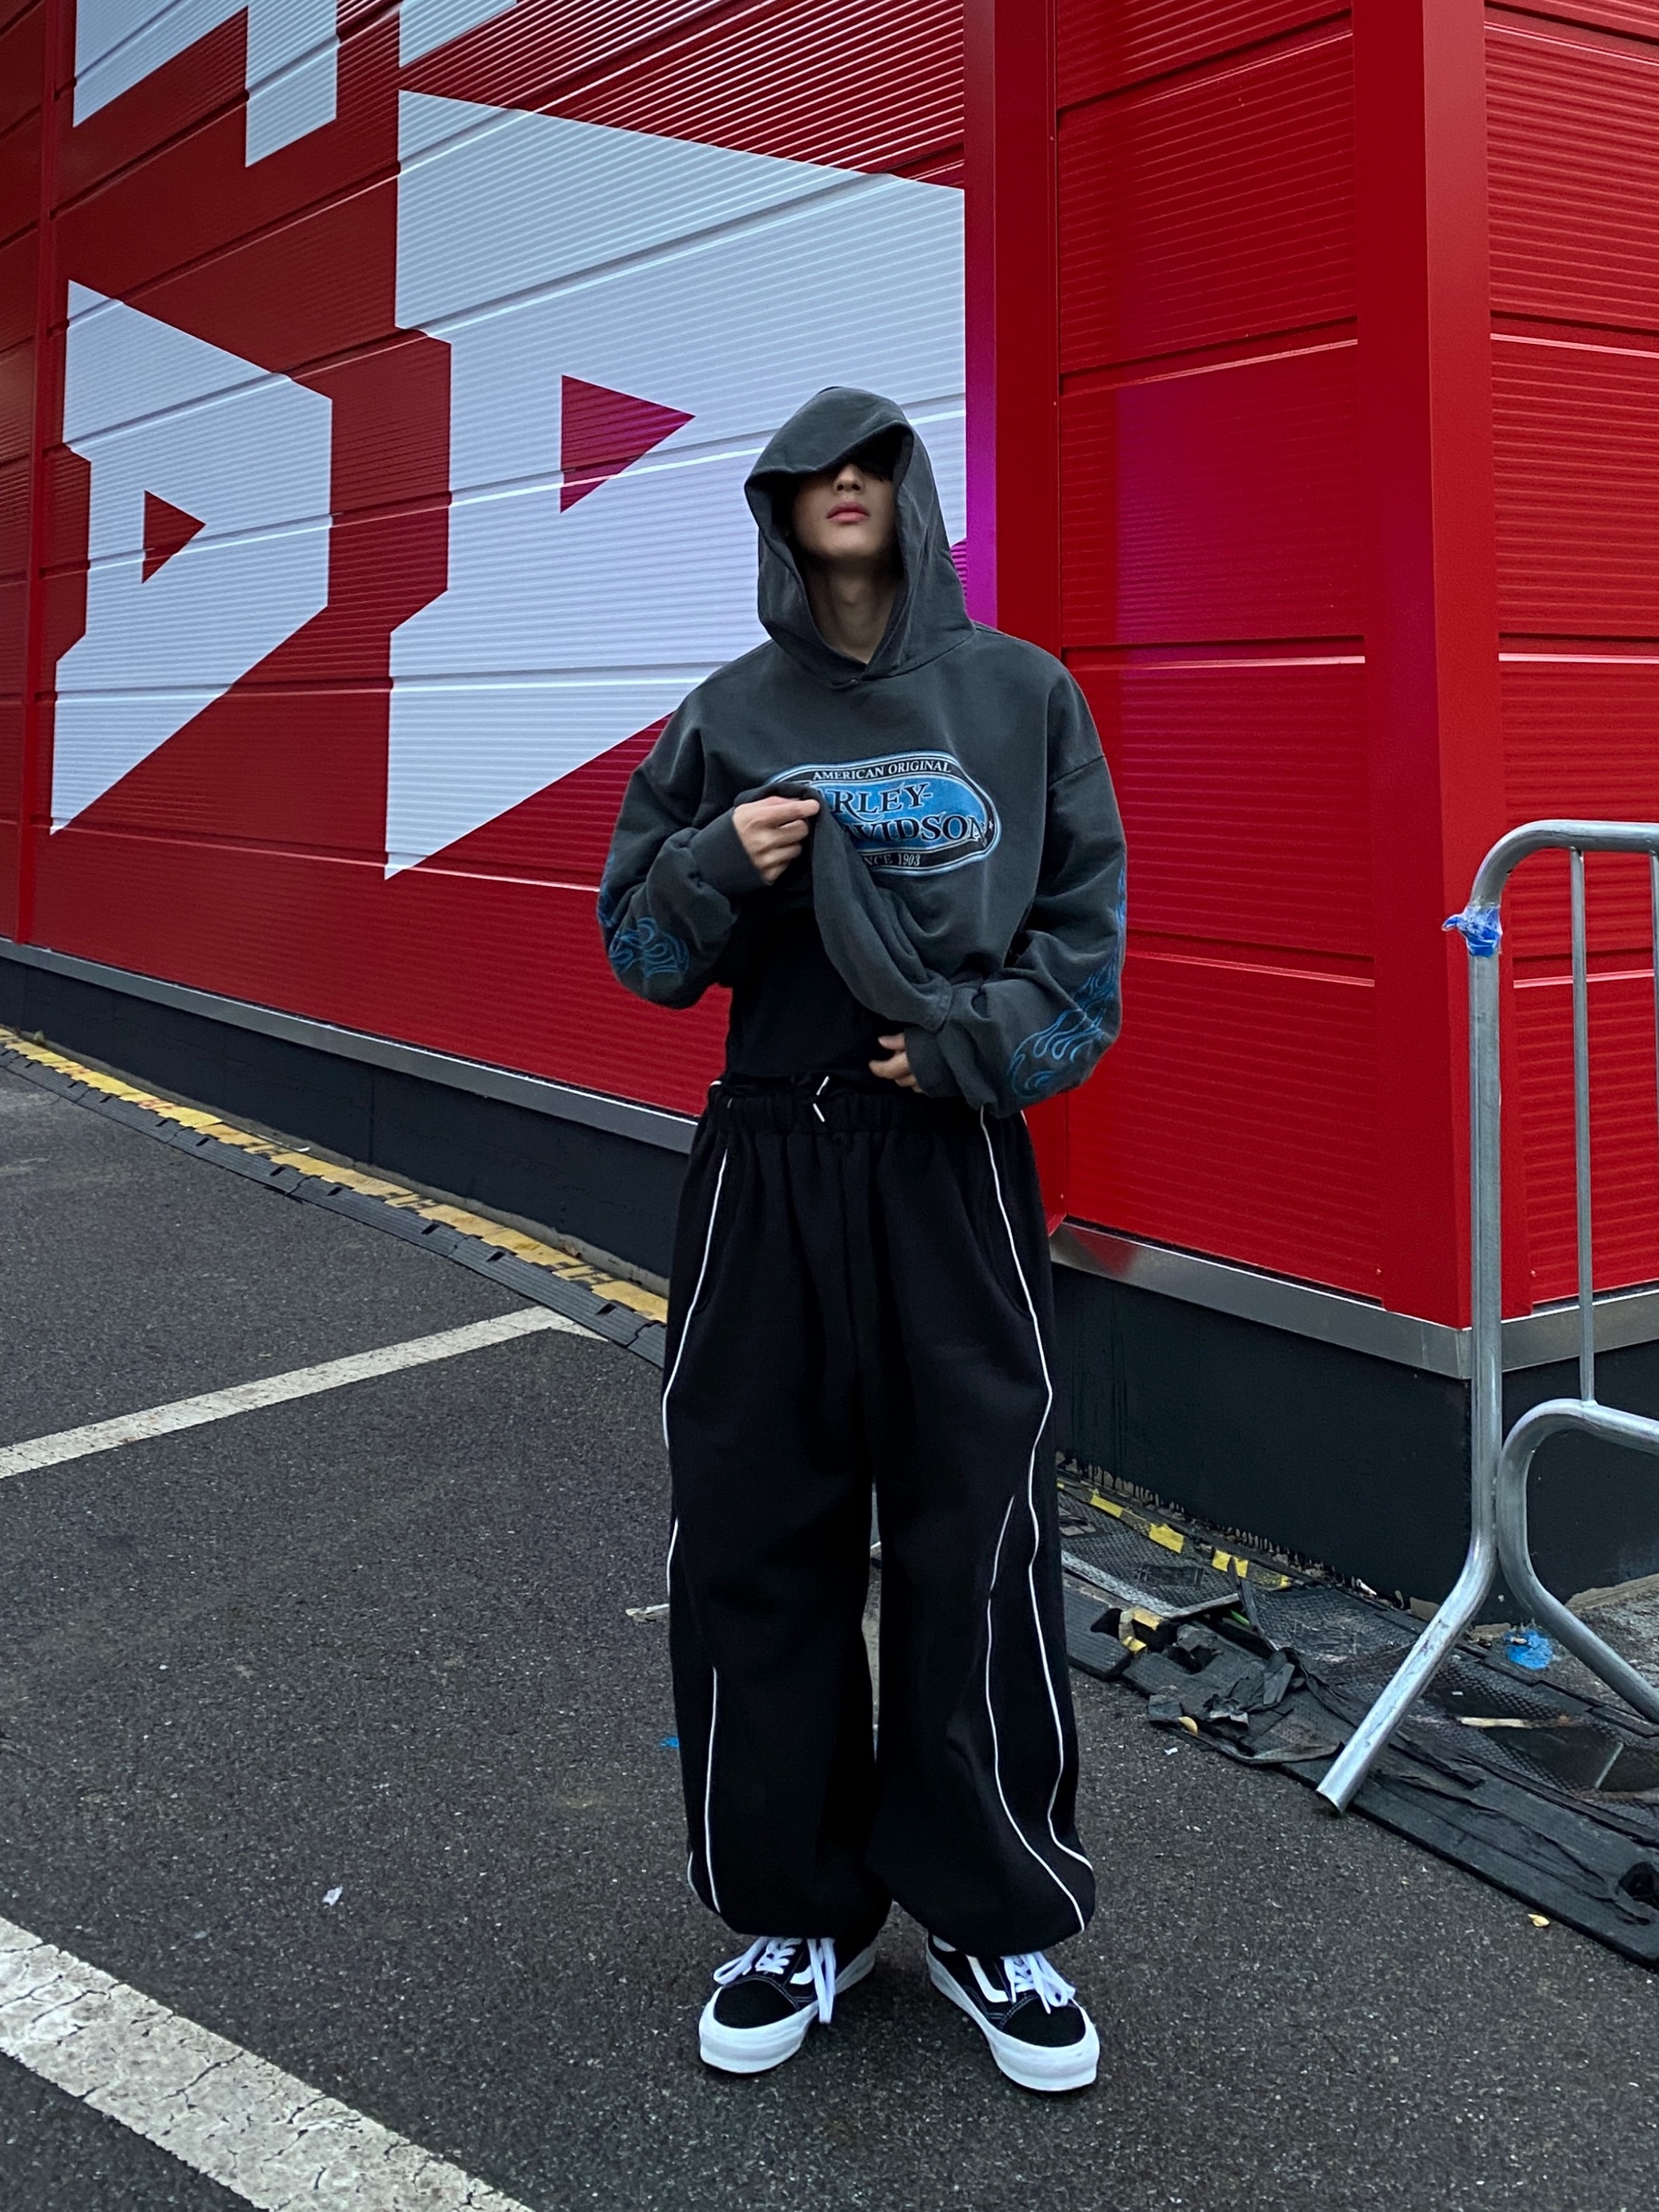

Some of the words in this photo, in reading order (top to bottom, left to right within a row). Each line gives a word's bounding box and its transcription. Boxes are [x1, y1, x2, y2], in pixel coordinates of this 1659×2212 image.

[813, 765, 885, 781] AMERICAN
[888, 760, 951, 775] ORIGINAL
[818, 781, 933, 823] RLEY-
[843, 812, 988, 848] VIDSON
[864, 852, 893, 866] NCE
[897, 852, 921, 867] 1903
